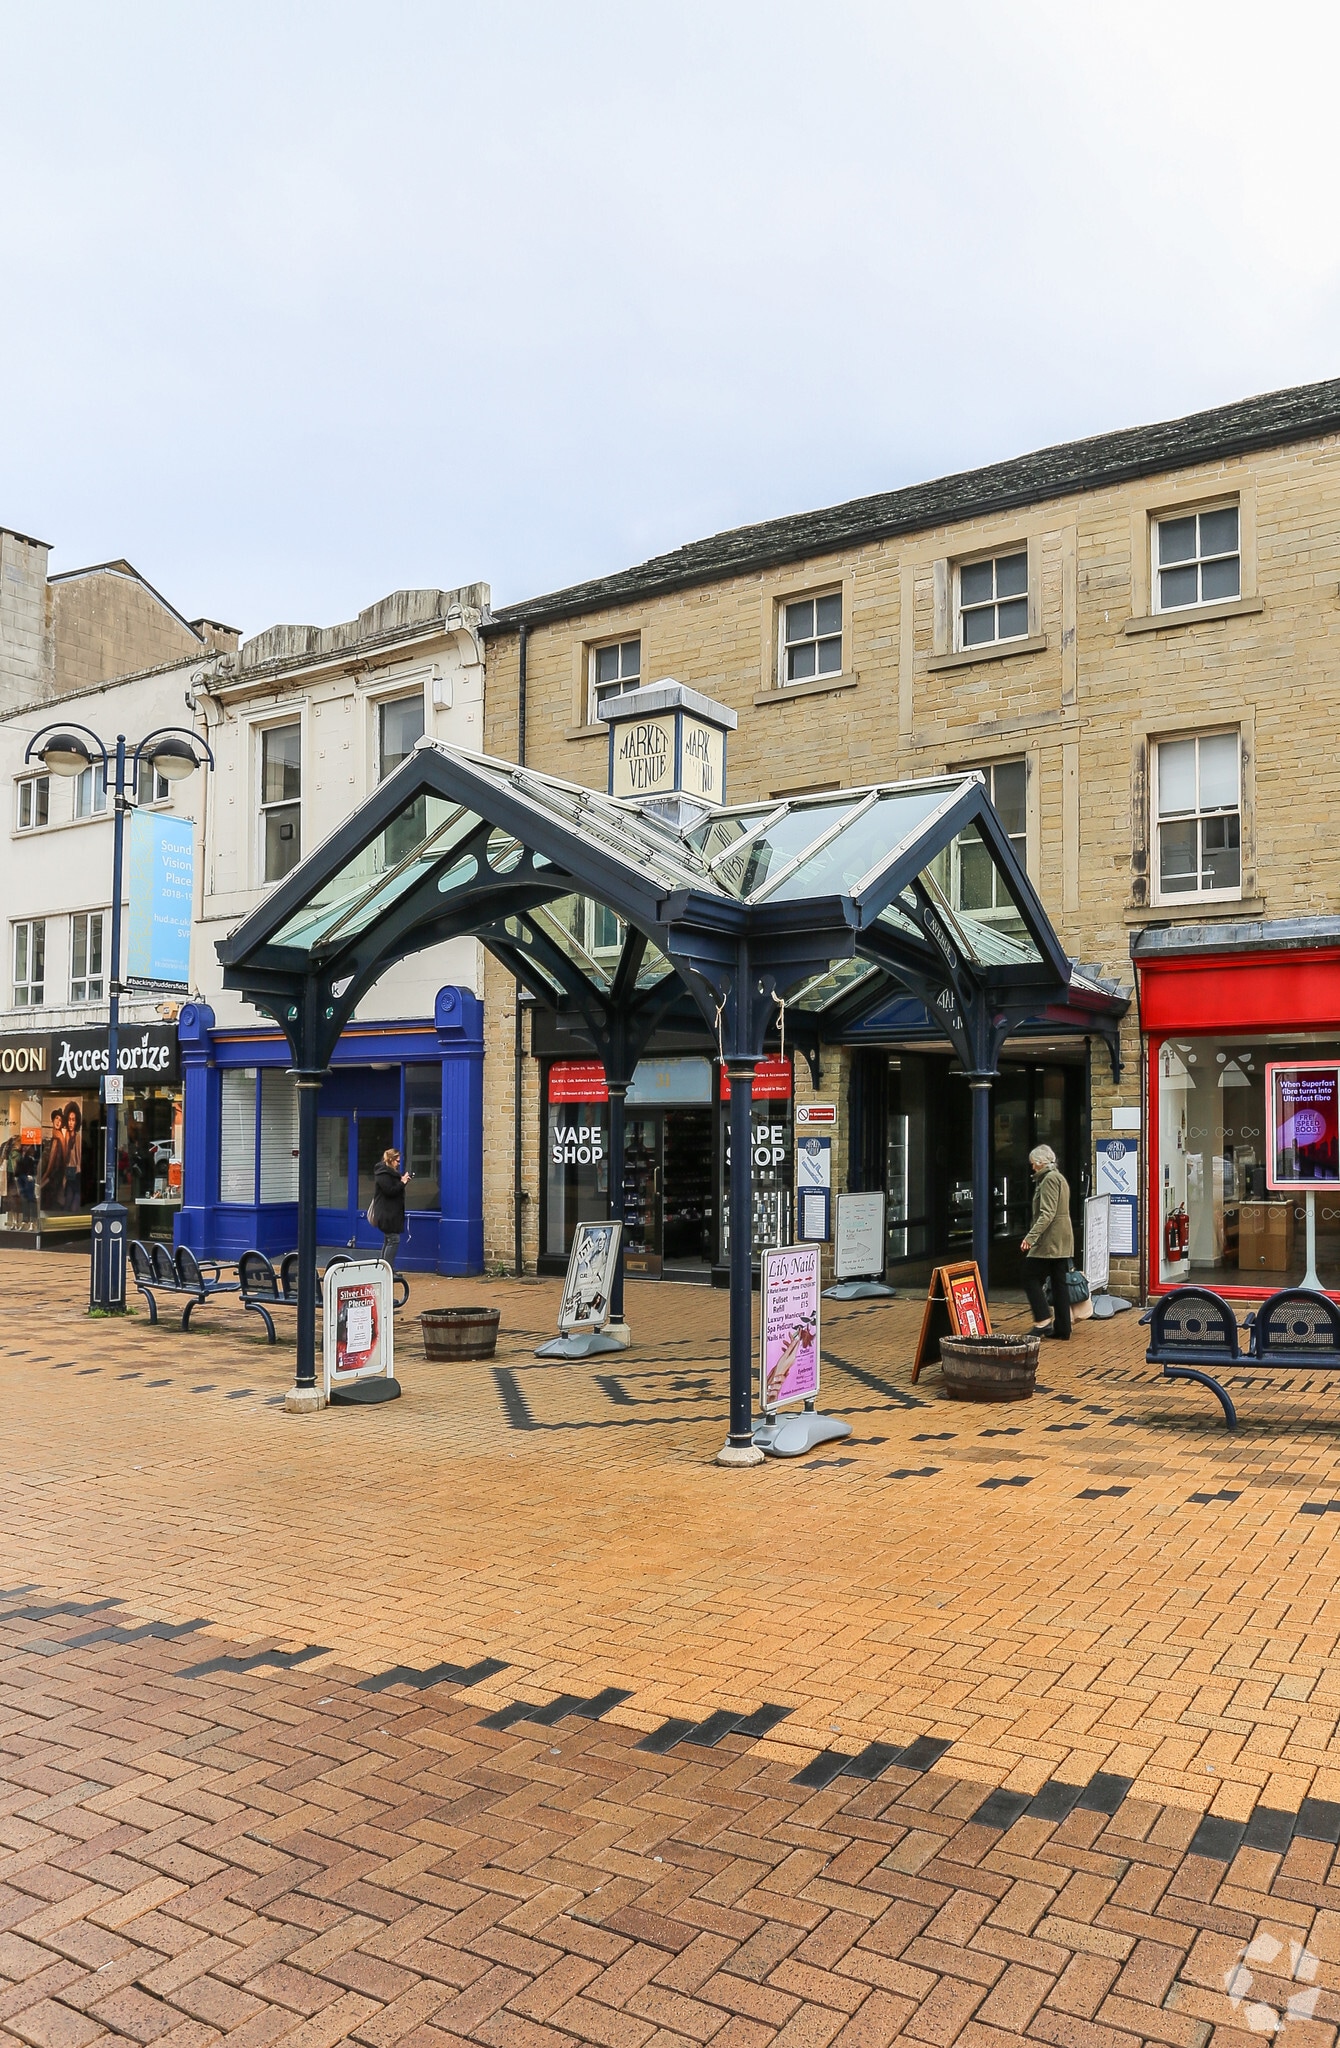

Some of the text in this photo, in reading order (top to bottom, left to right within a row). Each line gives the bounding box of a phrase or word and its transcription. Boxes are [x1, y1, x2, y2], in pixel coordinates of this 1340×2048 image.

[619, 725, 668, 759] MARKET
[629, 755, 666, 788] VENUE
[161, 839, 194, 855] Sound.
[162, 856, 194, 871] Vision.
[0, 1048, 44, 1073] OON
[56, 1032, 170, 1079] Accesorize
[1301, 1080, 1336, 1088] Superfast
[1318, 1086, 1332, 1094] into
[554, 1127, 602, 1144] VAPE
[727, 1125, 783, 1144] PE
[553, 1146, 603, 1164] SHOP
[726, 1147, 786, 1167] OP
[768, 1257, 788, 1281] Lily
[790, 1253, 815, 1275] Nails
[340, 1290, 359, 1300] Silver
[773, 1296, 788, 1304] Fullset
[801, 1292, 809, 1300] £20
[348, 1299, 375, 1308] Piercing
[773, 1300, 809, 1313] Refill £15
[767, 1311, 805, 1324] Luxury Manicure
[767, 1322, 794, 1334] Spa Pedicure
